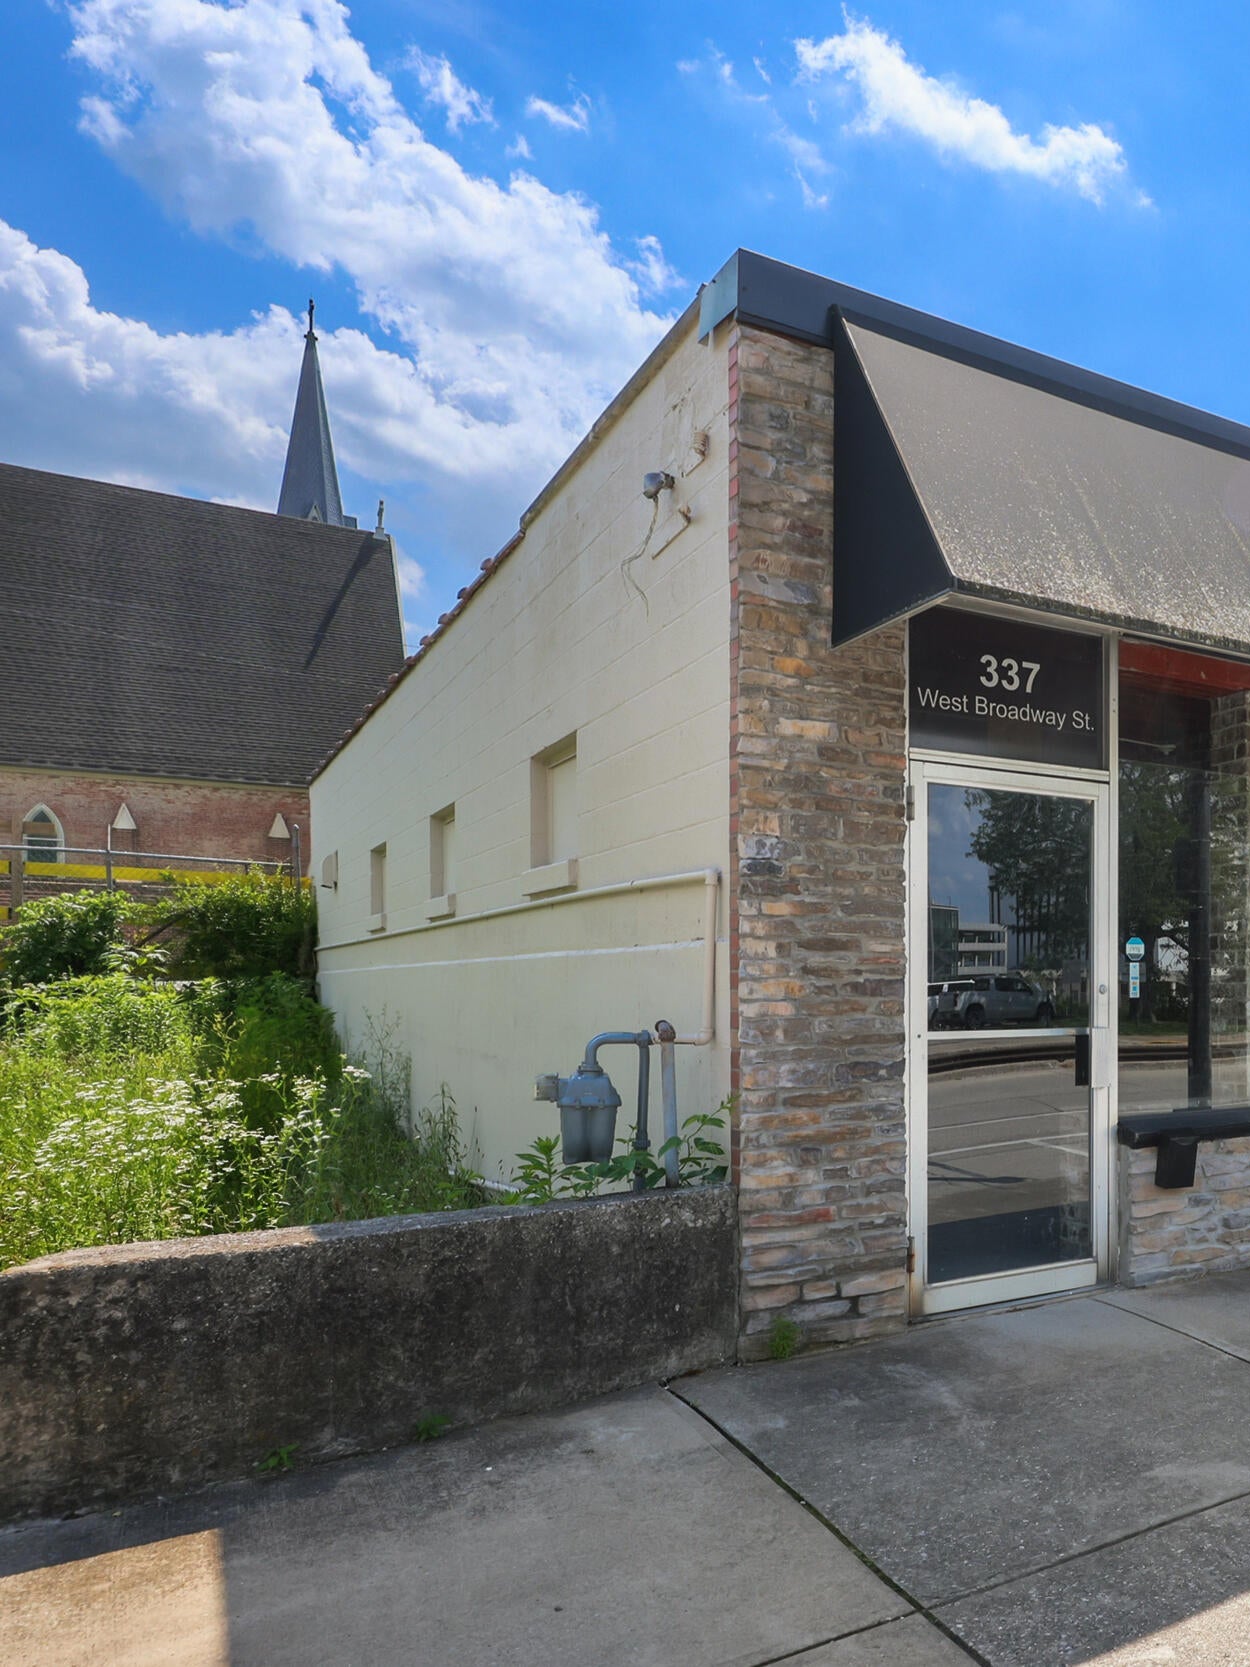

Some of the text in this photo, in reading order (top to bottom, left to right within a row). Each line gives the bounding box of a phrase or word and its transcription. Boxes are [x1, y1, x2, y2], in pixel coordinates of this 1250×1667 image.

[979, 654, 1041, 694] 337
[917, 686, 1095, 731] West Broadway St.
